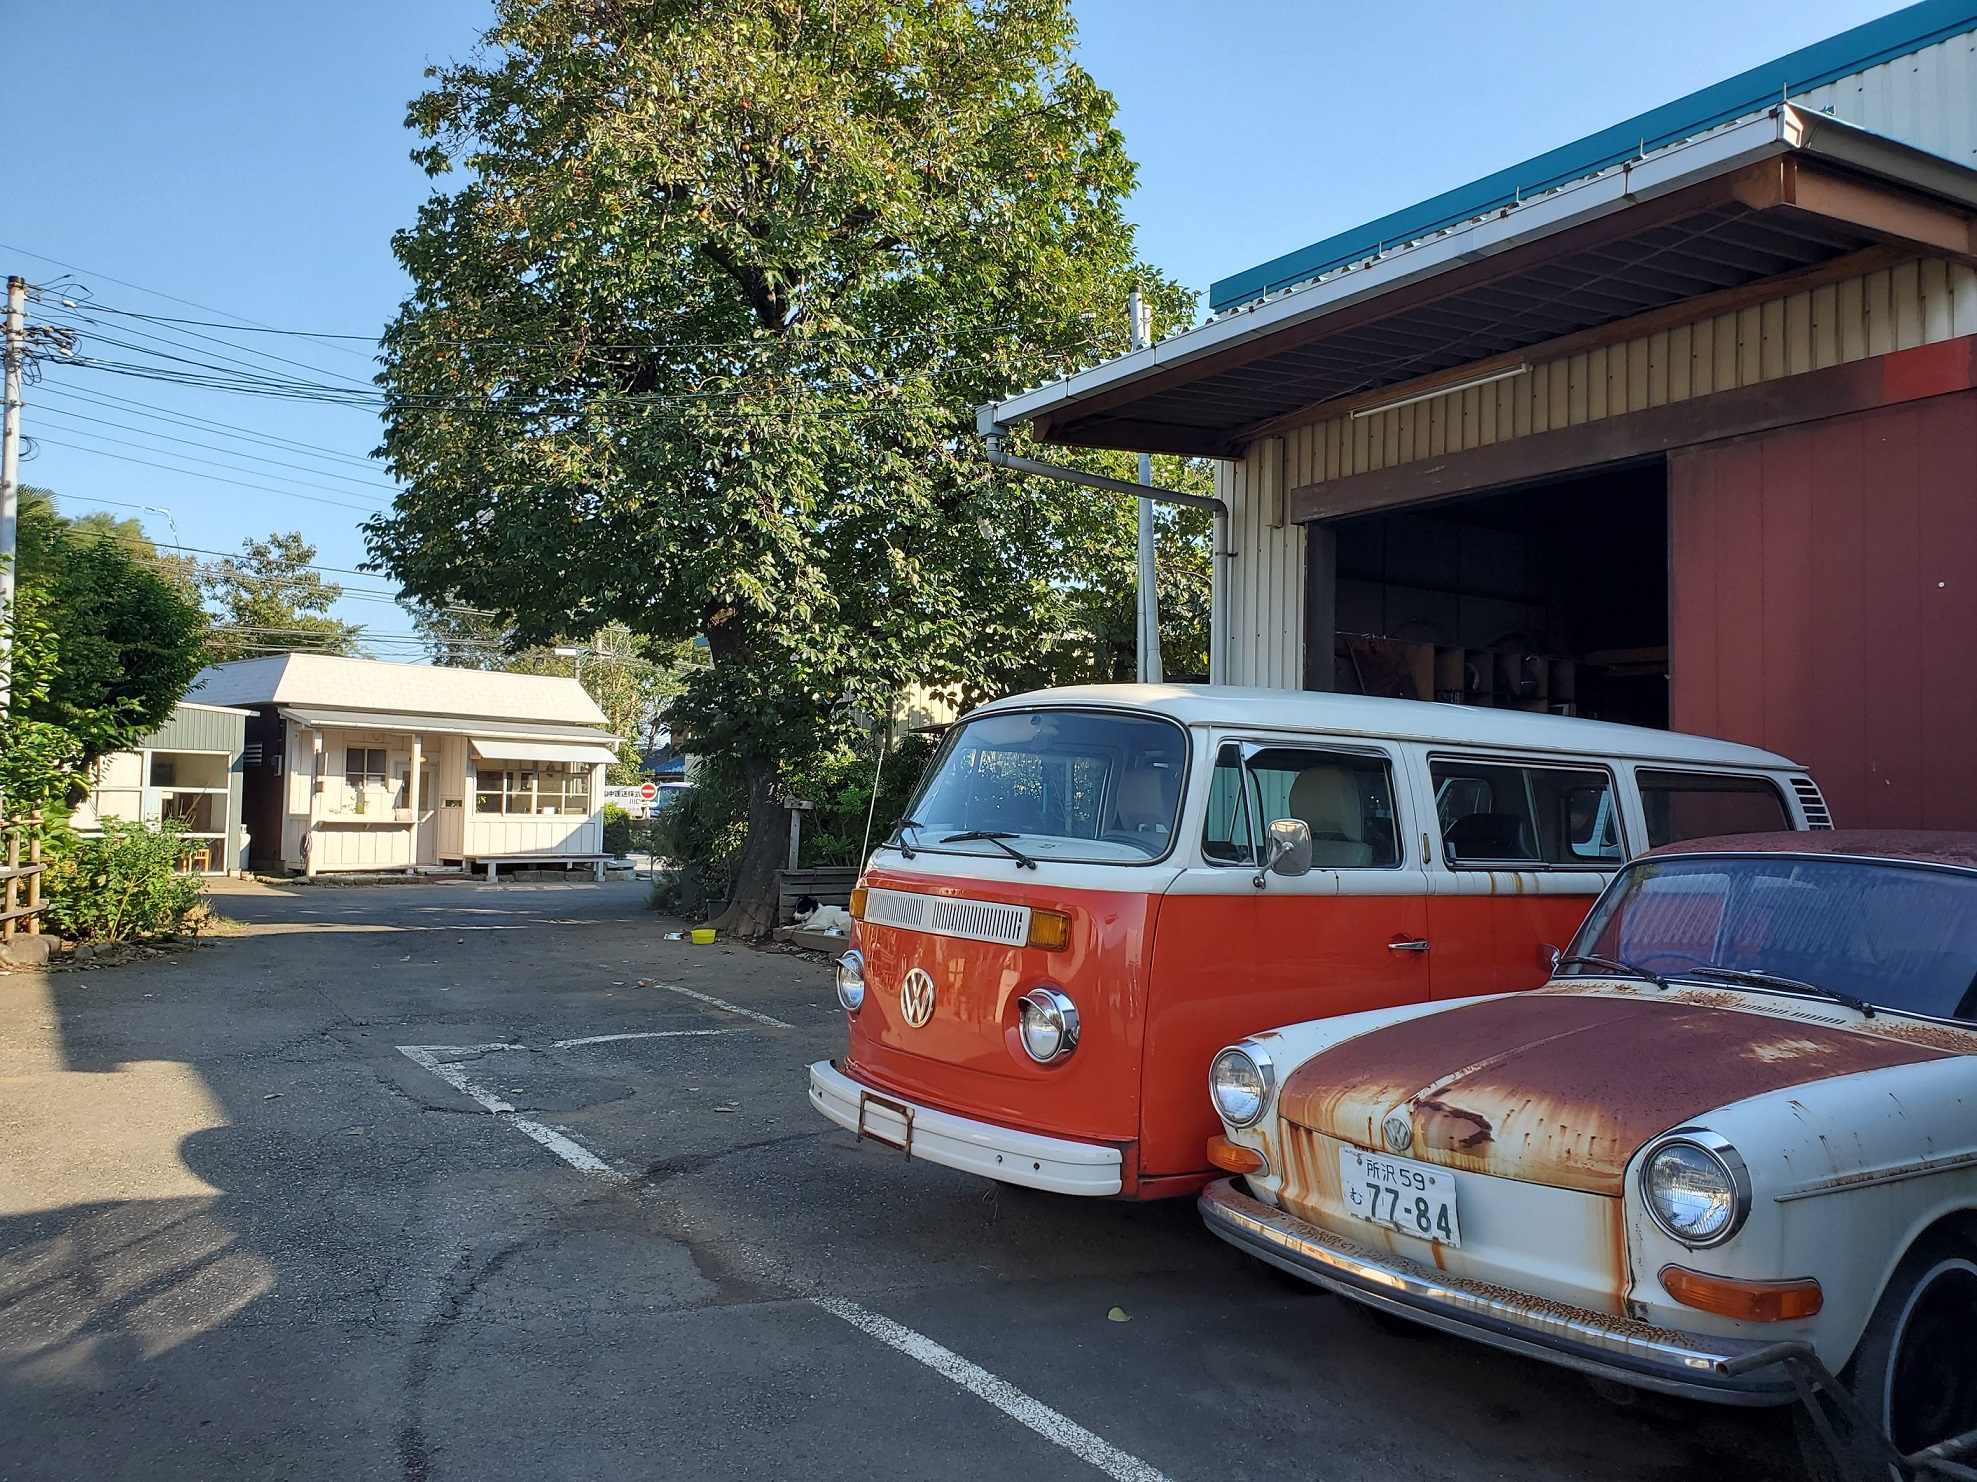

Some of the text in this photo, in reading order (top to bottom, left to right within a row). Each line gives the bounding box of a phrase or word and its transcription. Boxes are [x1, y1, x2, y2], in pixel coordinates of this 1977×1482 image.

[901, 967, 934, 1028] VW
[1384, 1117, 1412, 1151] VW
[1366, 1182, 1452, 1241] 77-84
